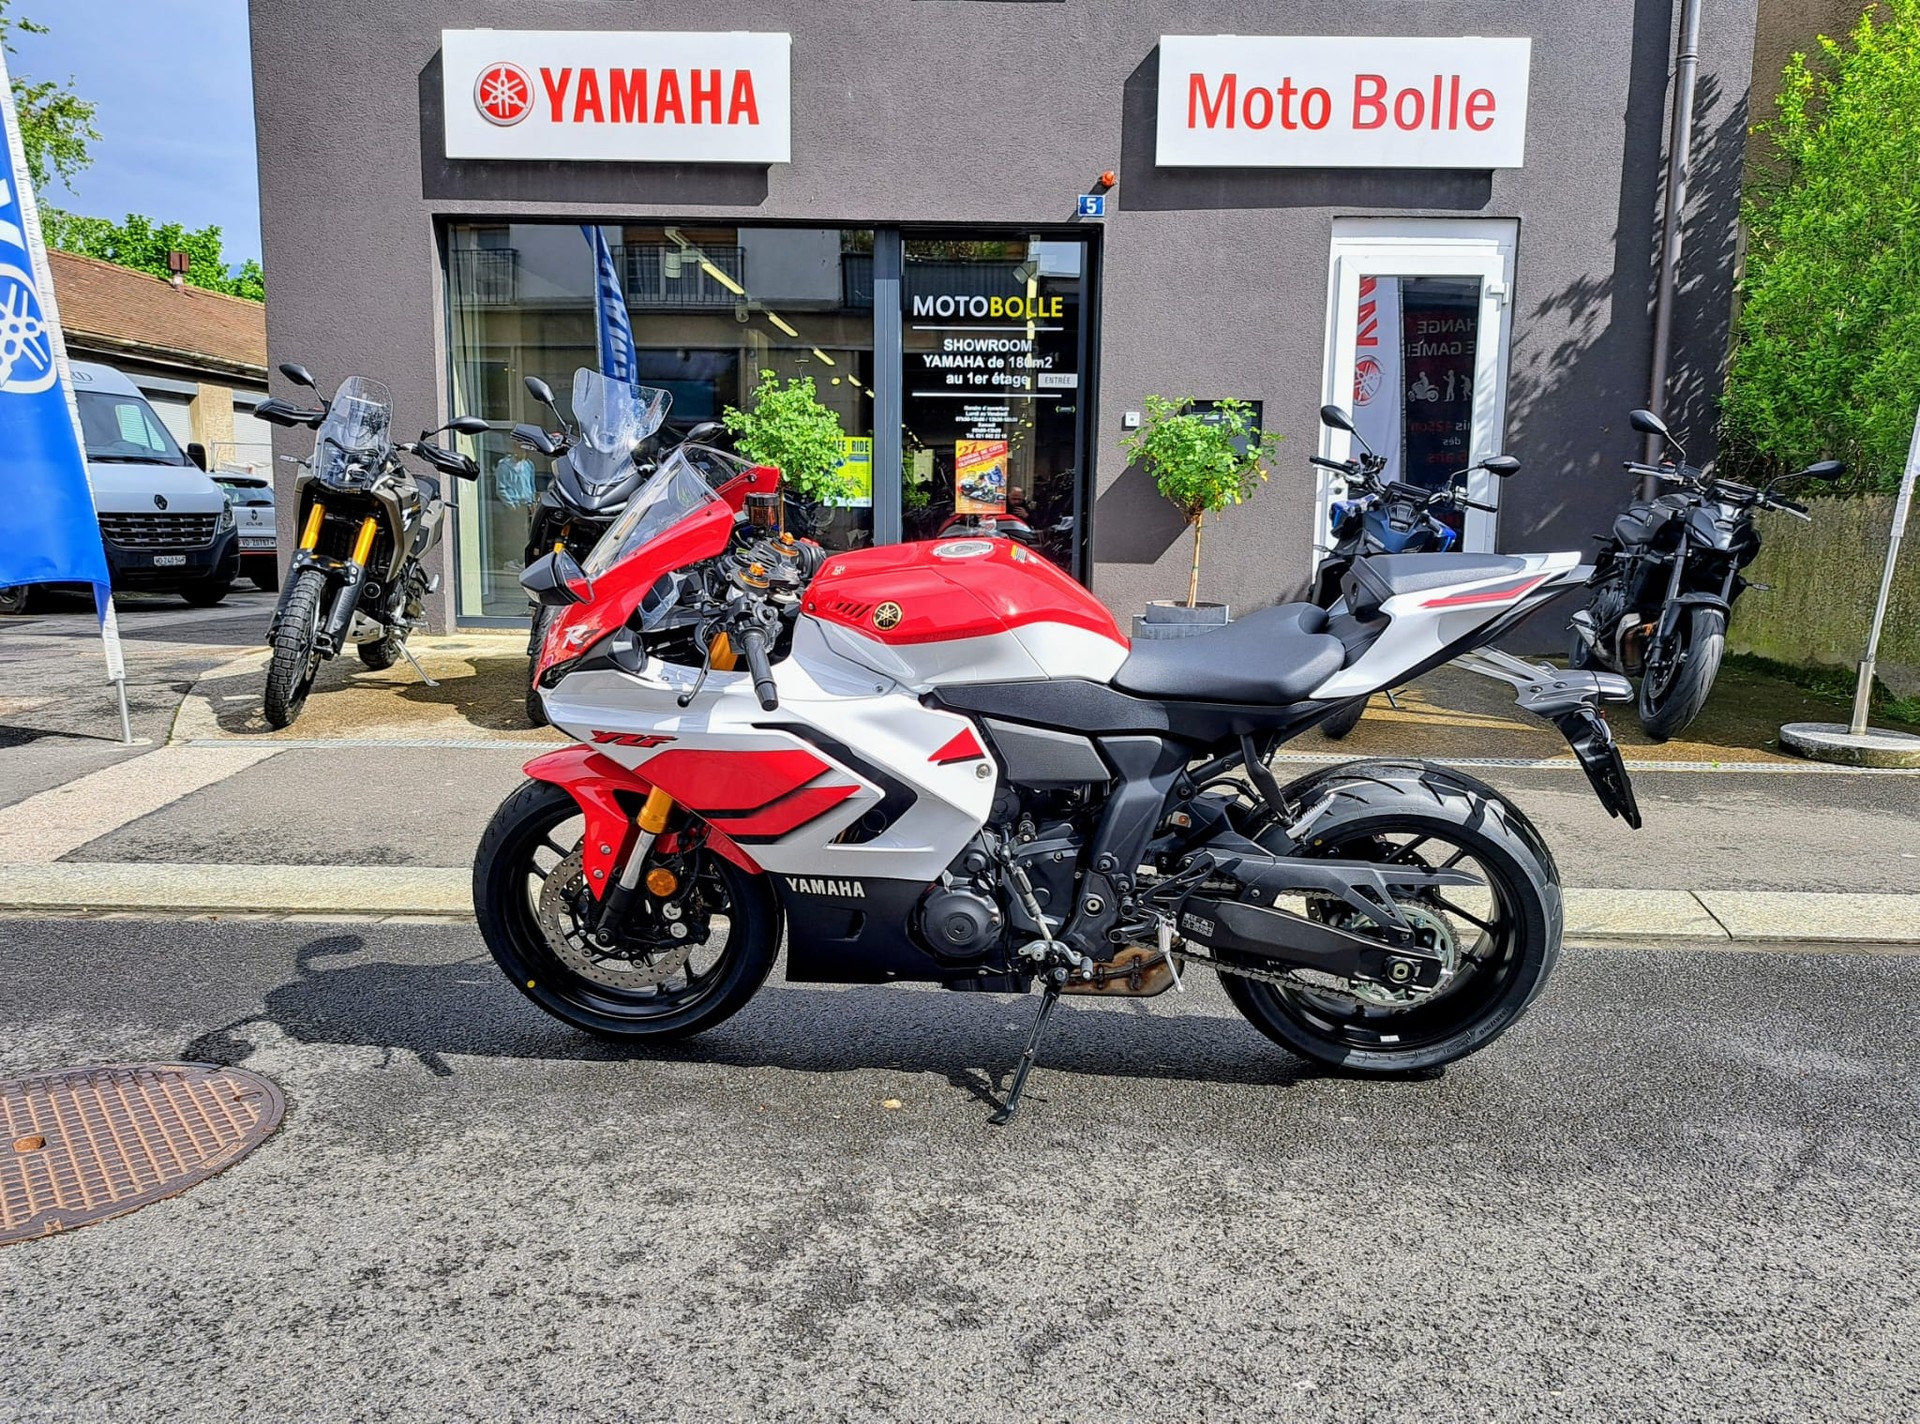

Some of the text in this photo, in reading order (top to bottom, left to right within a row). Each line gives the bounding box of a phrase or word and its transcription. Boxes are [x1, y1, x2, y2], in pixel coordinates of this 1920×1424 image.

[539, 67, 760, 125] YAMAHA
[1187, 73, 1496, 131] Moto Bolle
[1086, 197, 1097, 214] 5
[912, 295, 1064, 318] MOTOBOLLE
[943, 339, 1033, 352] SHOWROOM
[922, 354, 1053, 369] YAMAHA de 180m2
[945, 372, 1030, 387] au 1er étage
[851, 440, 869, 452] RIDE
[785, 877, 866, 898] YAMAHA
